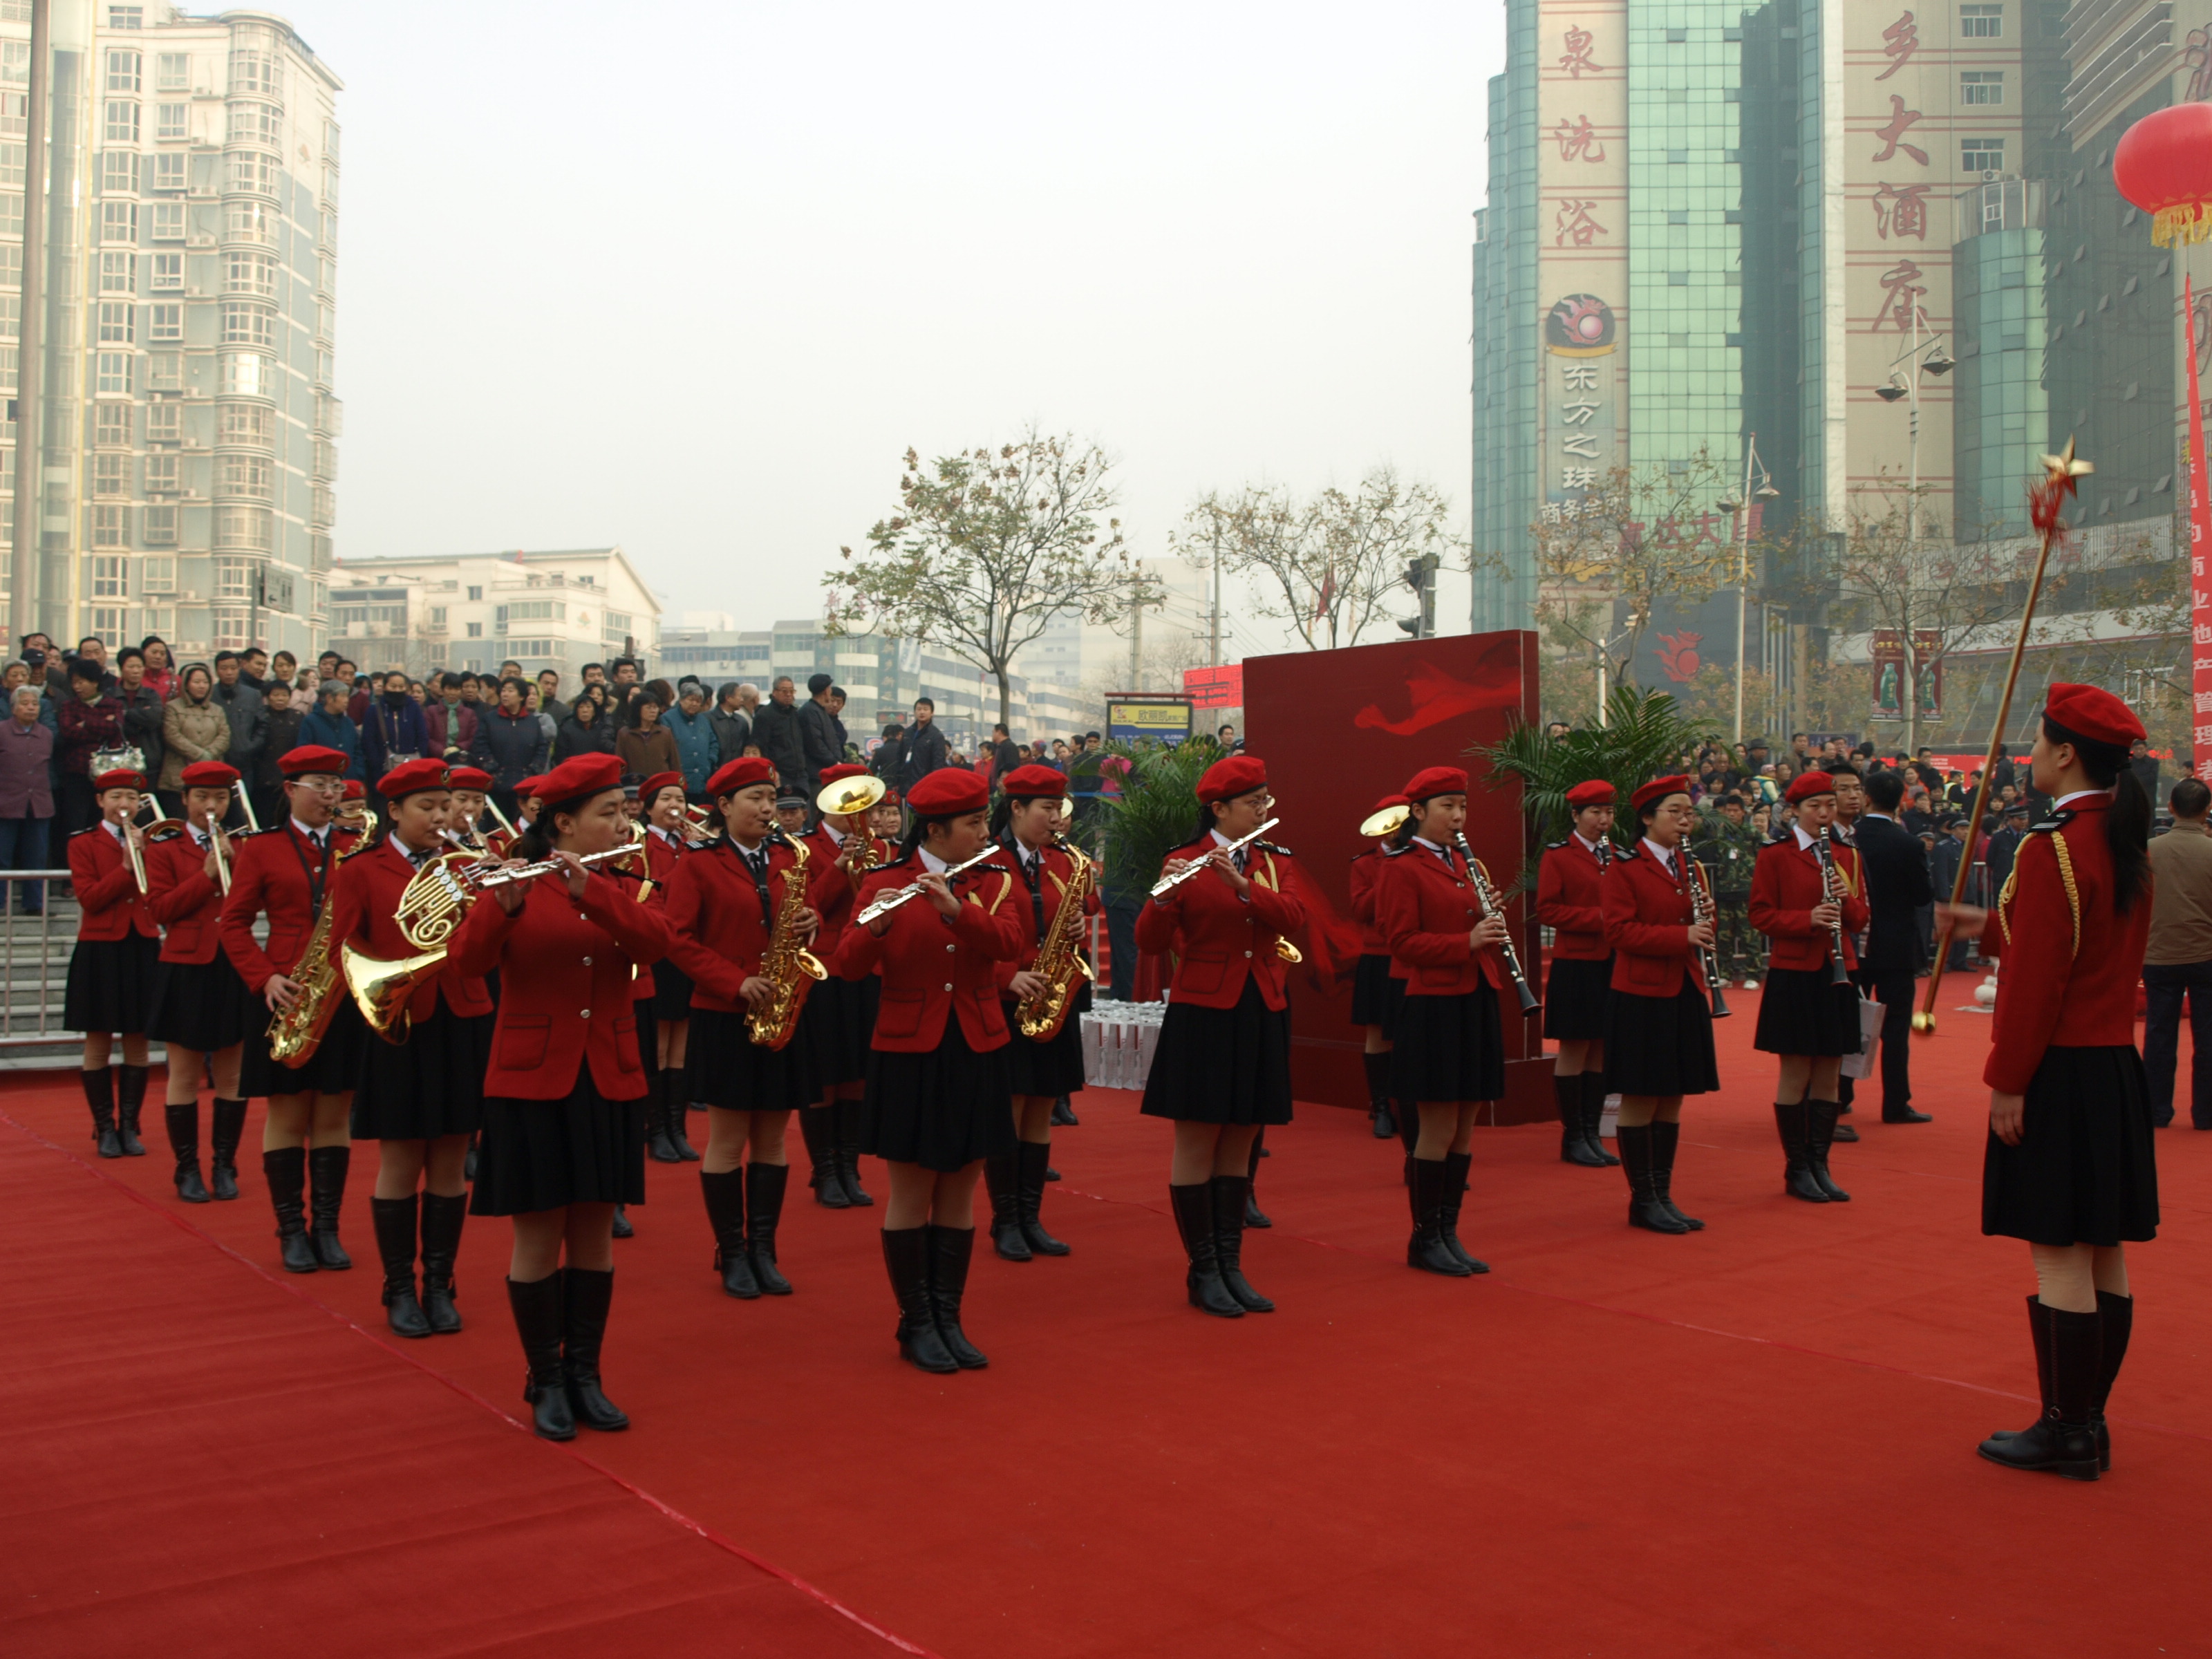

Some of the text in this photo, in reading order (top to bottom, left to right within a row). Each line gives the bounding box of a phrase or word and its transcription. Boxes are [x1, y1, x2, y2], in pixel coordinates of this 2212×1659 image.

[1873, 10, 1931, 332] 乡大酒店
[1563, 364, 1601, 491] 东方之珠
